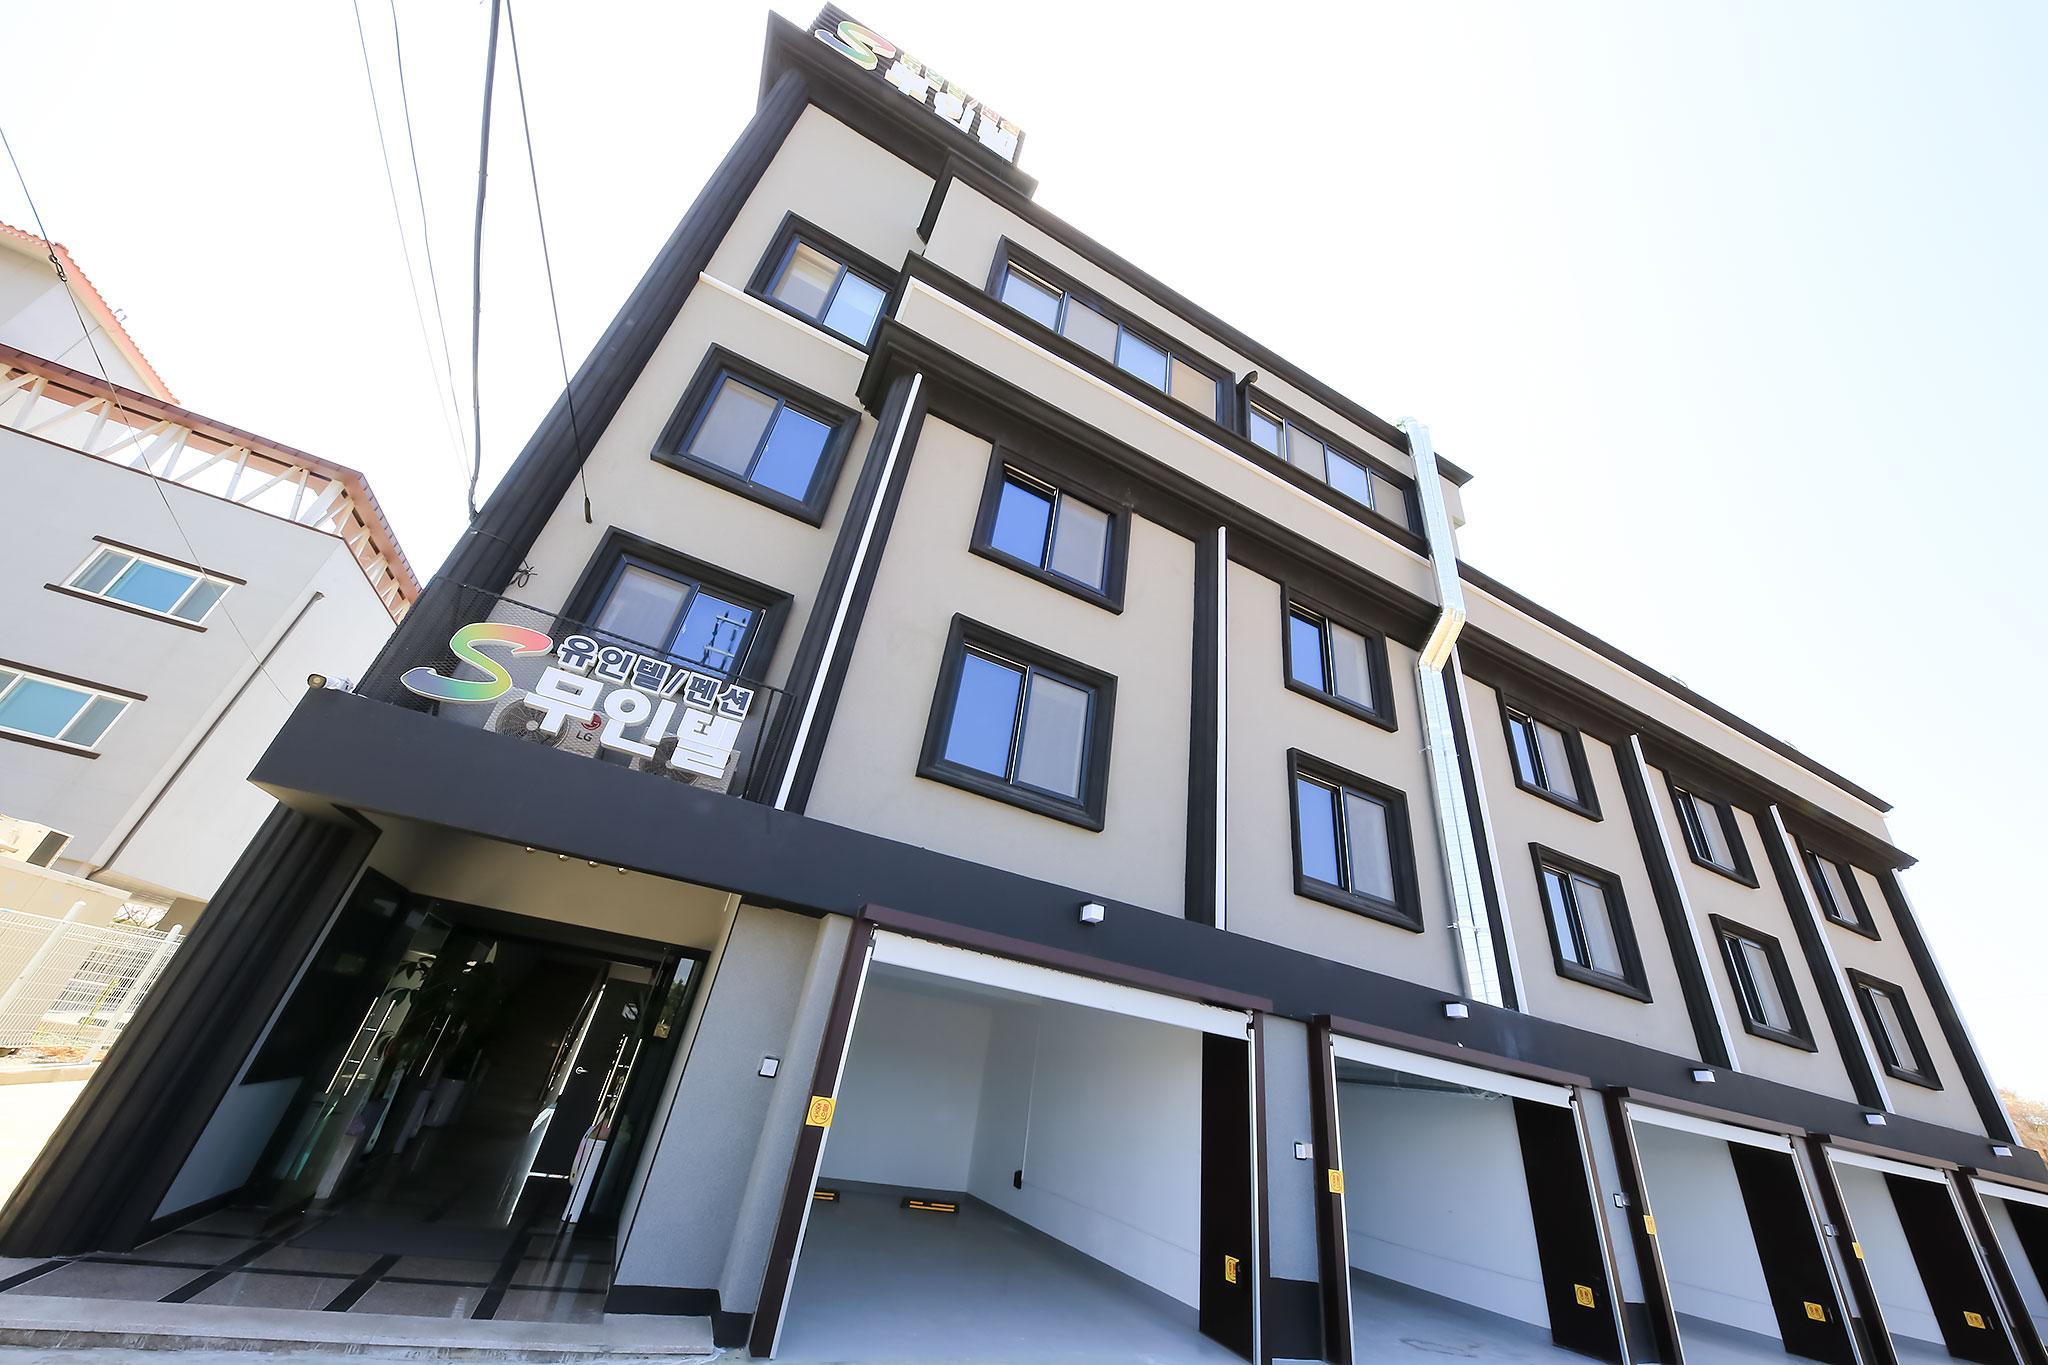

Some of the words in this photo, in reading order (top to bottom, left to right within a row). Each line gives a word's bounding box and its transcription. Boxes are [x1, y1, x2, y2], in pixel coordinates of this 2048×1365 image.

[400, 622, 554, 702] S
[557, 635, 754, 721] 유인텔/펜션
[524, 666, 744, 779] 무인텔
[575, 730, 593, 742] LG
